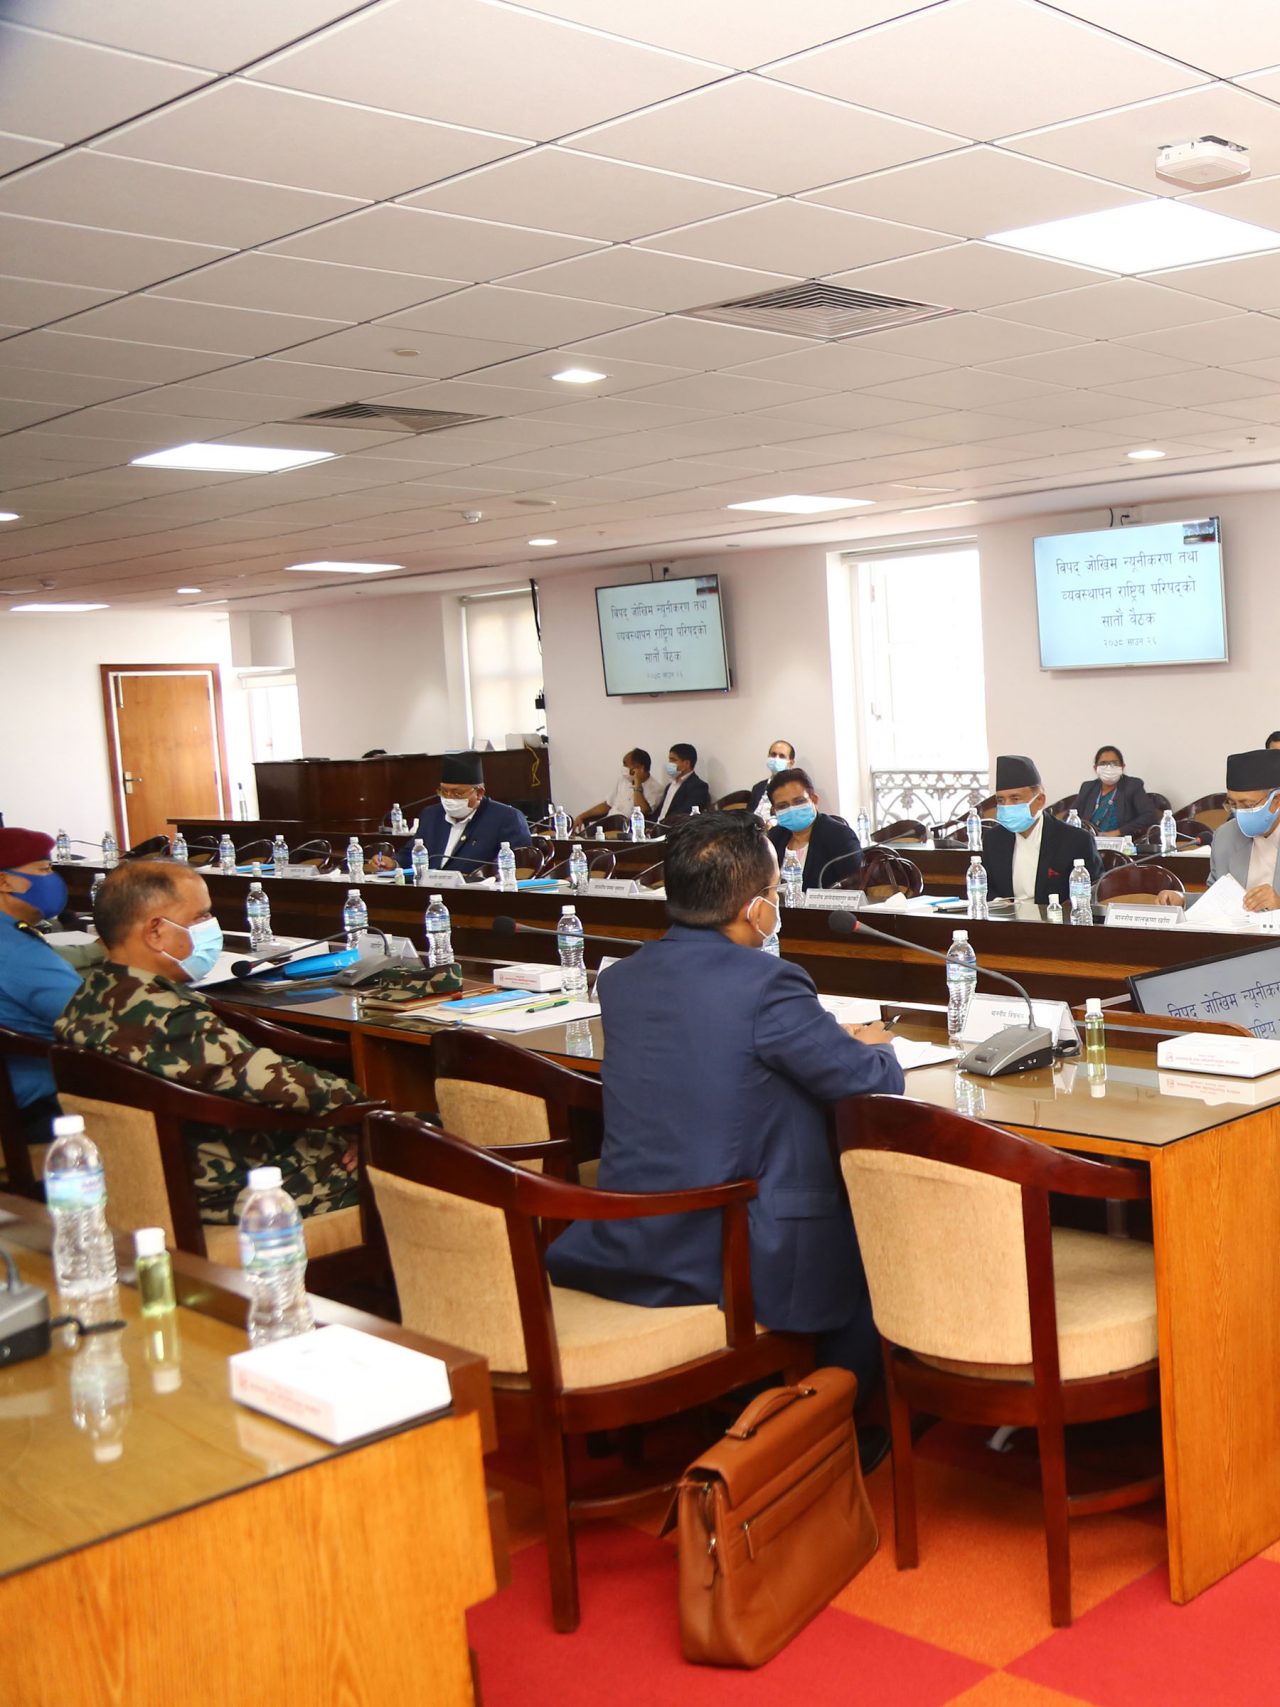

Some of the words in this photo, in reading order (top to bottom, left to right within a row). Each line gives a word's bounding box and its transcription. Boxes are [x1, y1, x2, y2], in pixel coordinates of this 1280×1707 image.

[1084, 554, 1118, 572] जोखिम
[1178, 550, 1199, 563] तथा
[1201, 991, 1239, 1015] जोखिम
